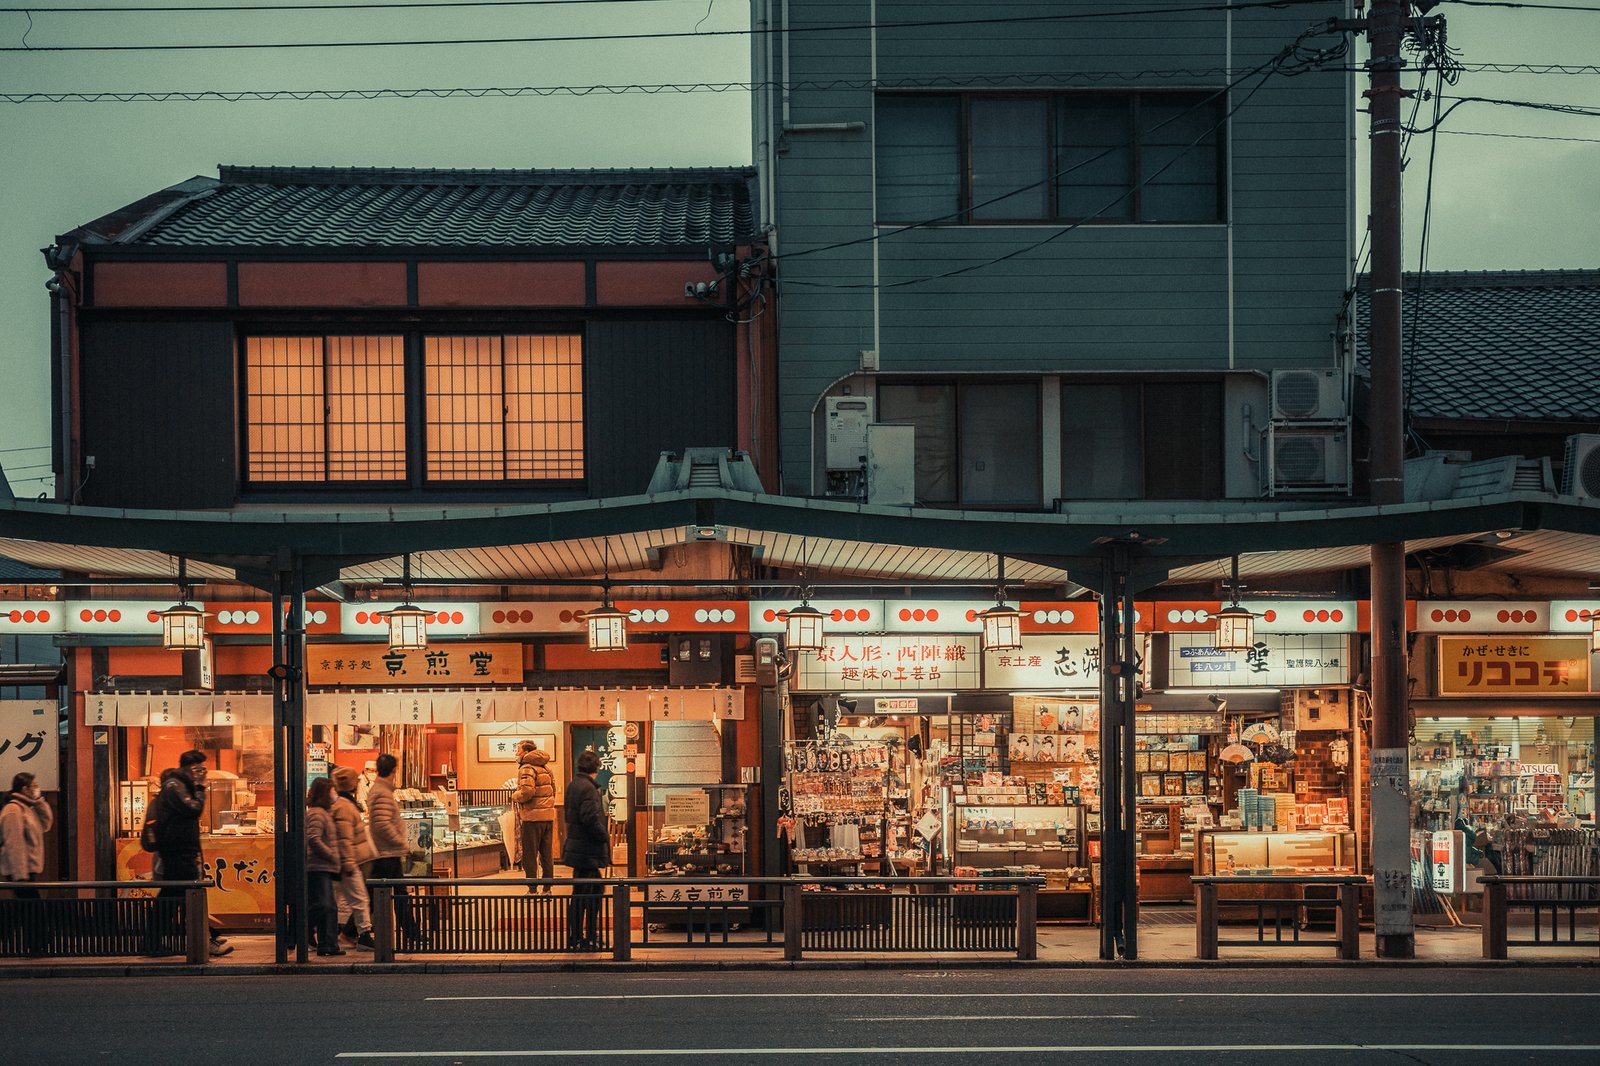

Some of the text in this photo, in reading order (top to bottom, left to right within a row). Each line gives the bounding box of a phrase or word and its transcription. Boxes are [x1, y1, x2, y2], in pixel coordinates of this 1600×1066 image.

[1245, 641, 1270, 673] 聖
[1462, 645, 1530, 657] かぜ・せきに
[320, 659, 372, 671] 京菓子処
[381, 650, 494, 677] 京煎堂
[998, 655, 1042, 667] 京土産
[841, 666, 941, 681] 趣味の工芸品
[1520, 764, 1556, 774] ATSUGI
[653, 888, 682, 902] 茶房
